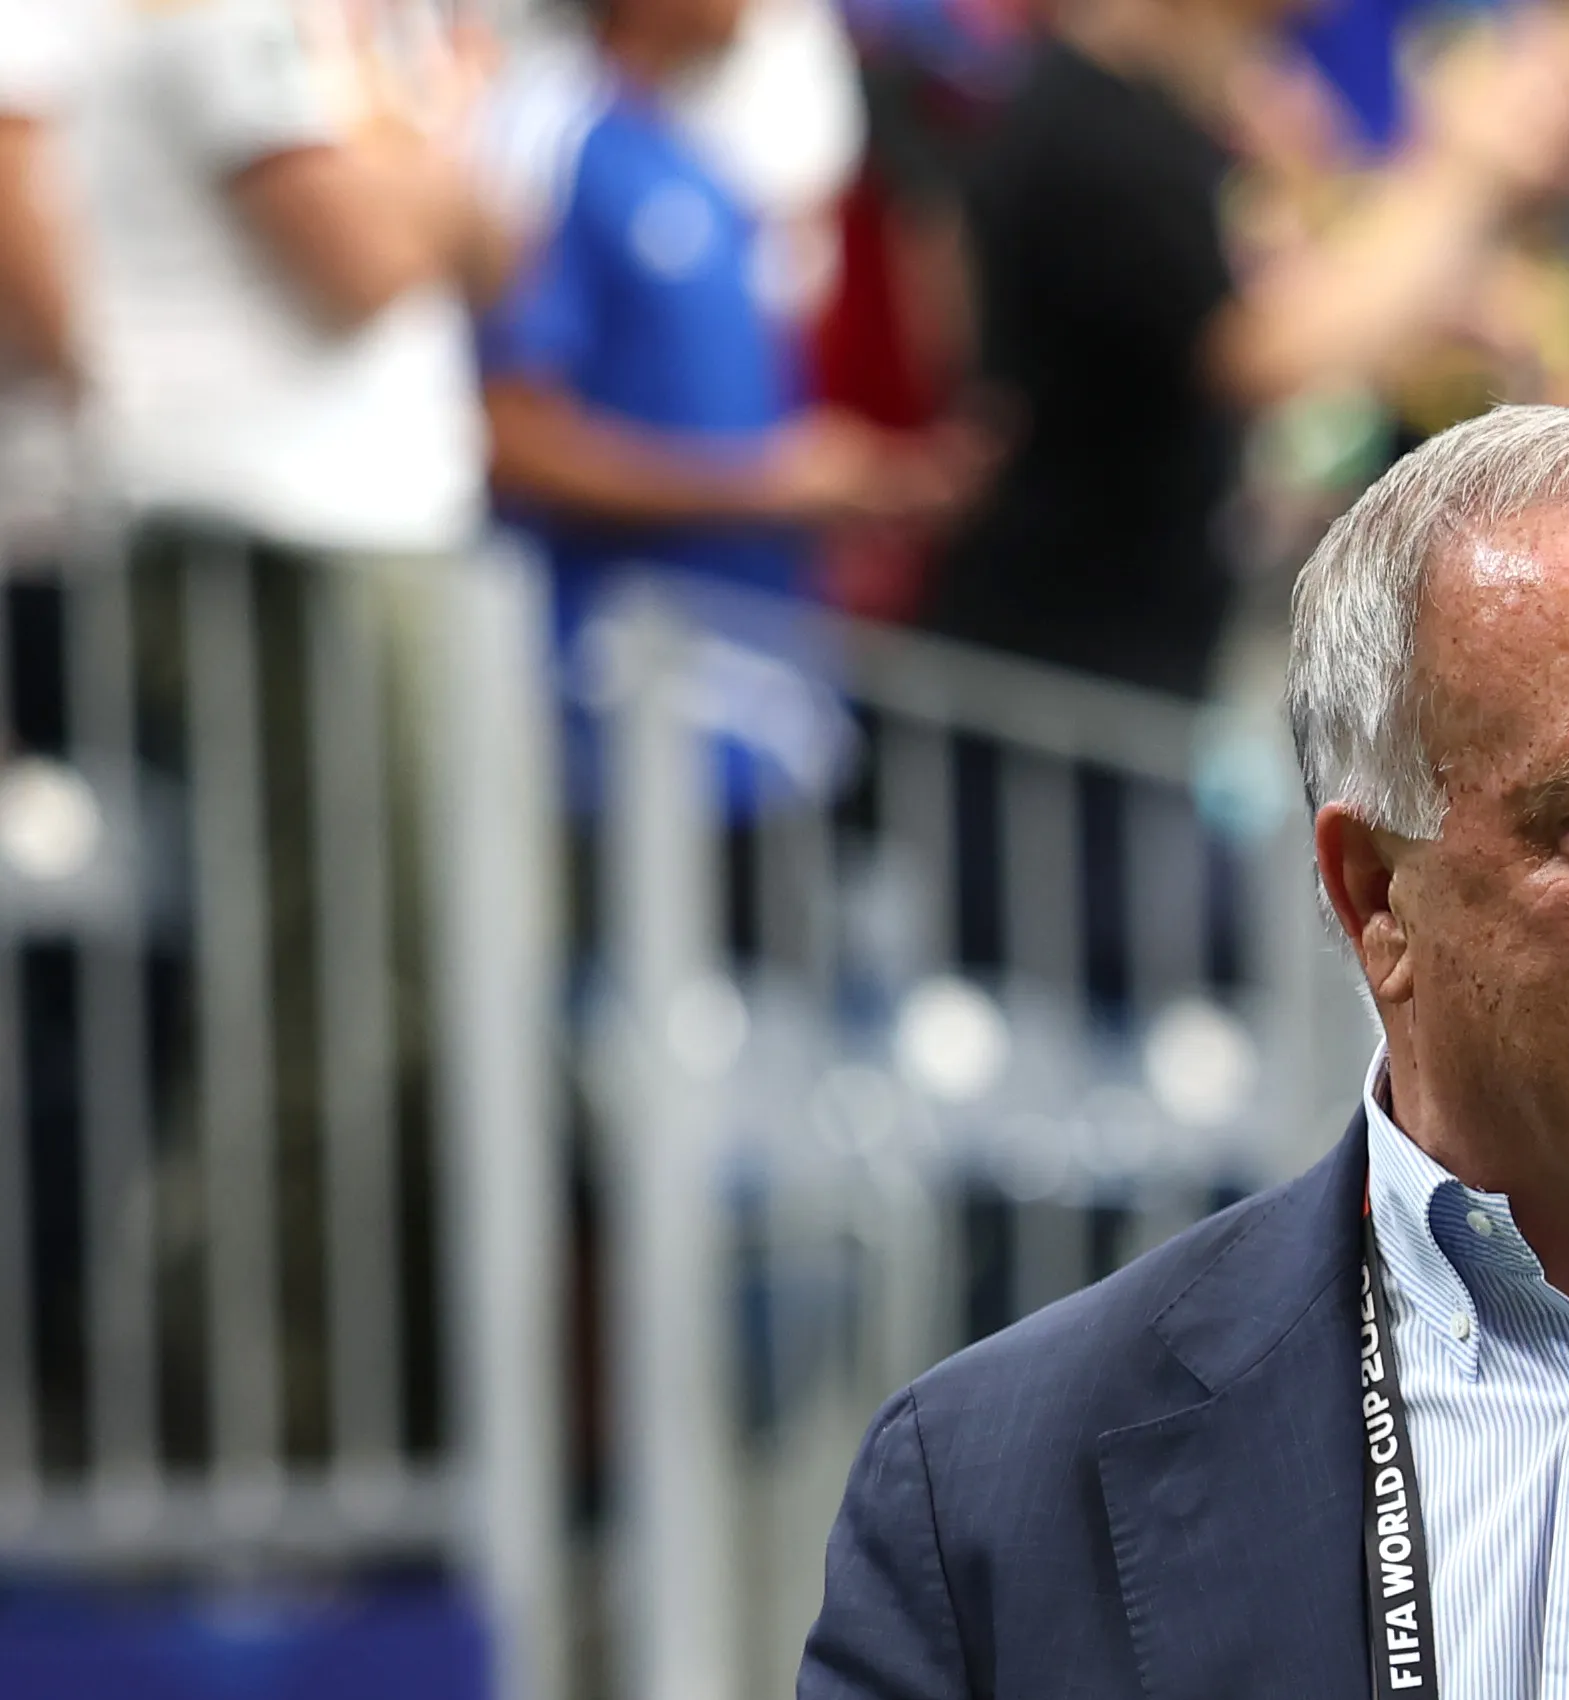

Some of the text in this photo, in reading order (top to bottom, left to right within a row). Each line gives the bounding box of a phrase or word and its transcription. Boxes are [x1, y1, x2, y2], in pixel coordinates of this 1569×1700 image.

[1363, 1391, 1399, 1465] CUP
[1375, 1466, 1415, 1598] WORLD
[1385, 1601, 1423, 1689] FIFA
